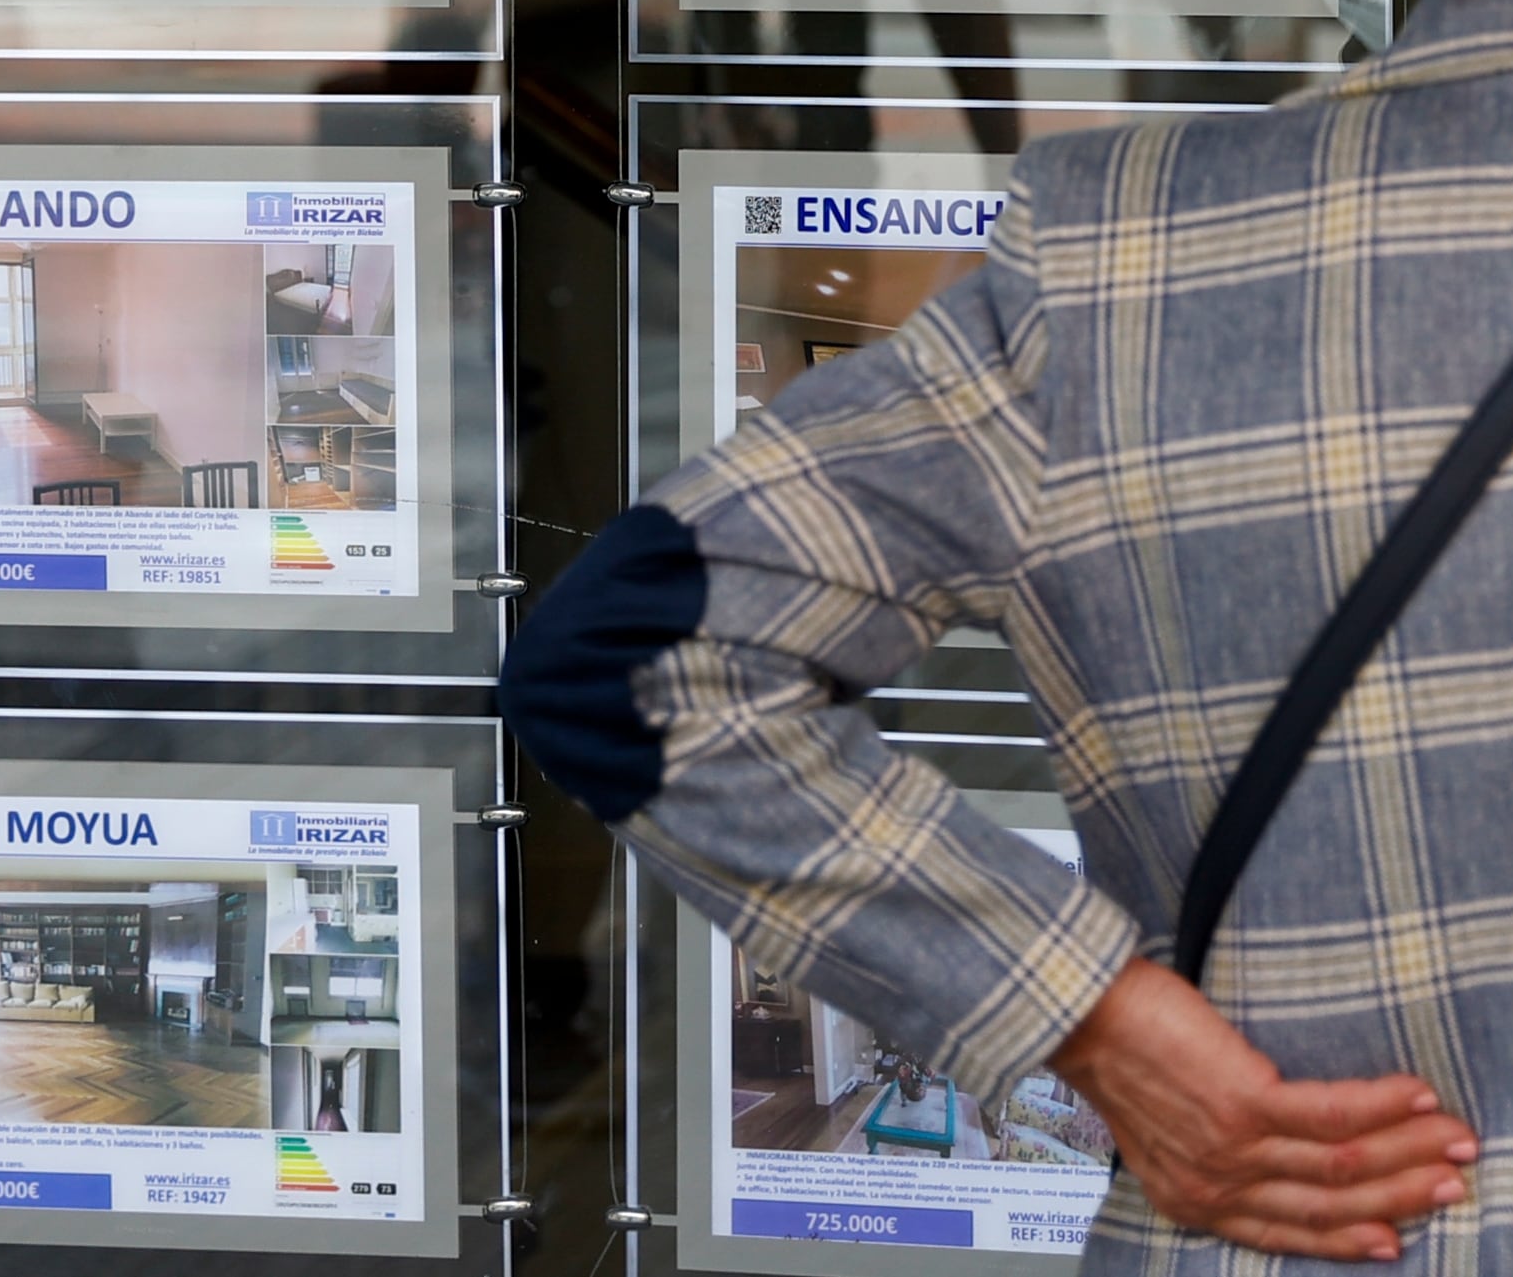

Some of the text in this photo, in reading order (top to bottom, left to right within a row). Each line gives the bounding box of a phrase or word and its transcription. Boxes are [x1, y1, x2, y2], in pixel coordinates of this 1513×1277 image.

[293, 196, 383, 206] Inmobiliaria
[293, 209, 382, 223] IRIZAR
[797, 197, 1003, 236] ENSANCH
[140, 554, 226, 566] www.irizar.es
[143, 571, 221, 583] REF: 19851
[7, 811, 158, 846] MOYUA
[297, 816, 387, 827] Inmobiliaria
[297, 829, 386, 844] IRIZAR
[145, 1173, 230, 1186] www.irizar.es
[147, 1190, 226, 1204] REF: 19427
[806, 1212, 898, 1235] 725.000€
[1011, 1227, 1043, 1241] REF:
